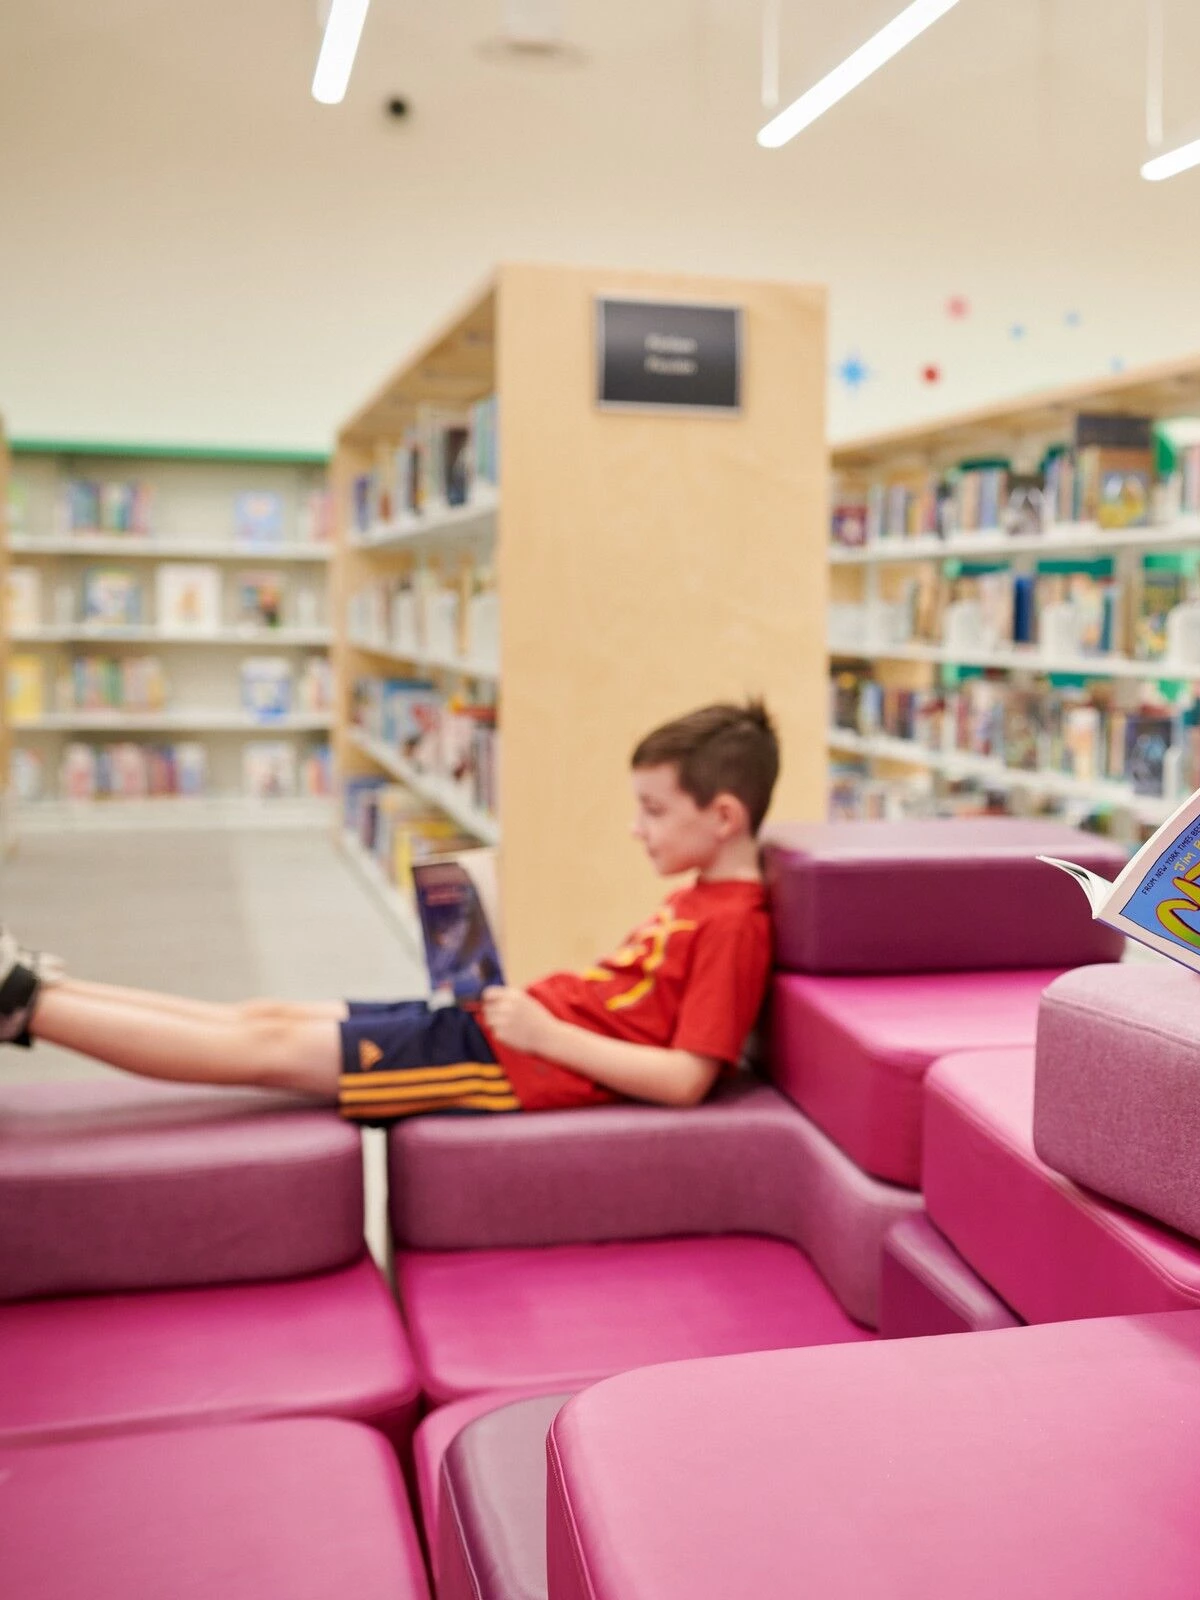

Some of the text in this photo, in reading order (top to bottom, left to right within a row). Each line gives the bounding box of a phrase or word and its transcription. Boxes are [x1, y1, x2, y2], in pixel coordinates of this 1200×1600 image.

[1142, 878, 1157, 895] FROM
[1156, 866, 1167, 878] NEW
[1165, 850, 1180, 865] YORK
[1178, 835, 1193, 851] TIMES
